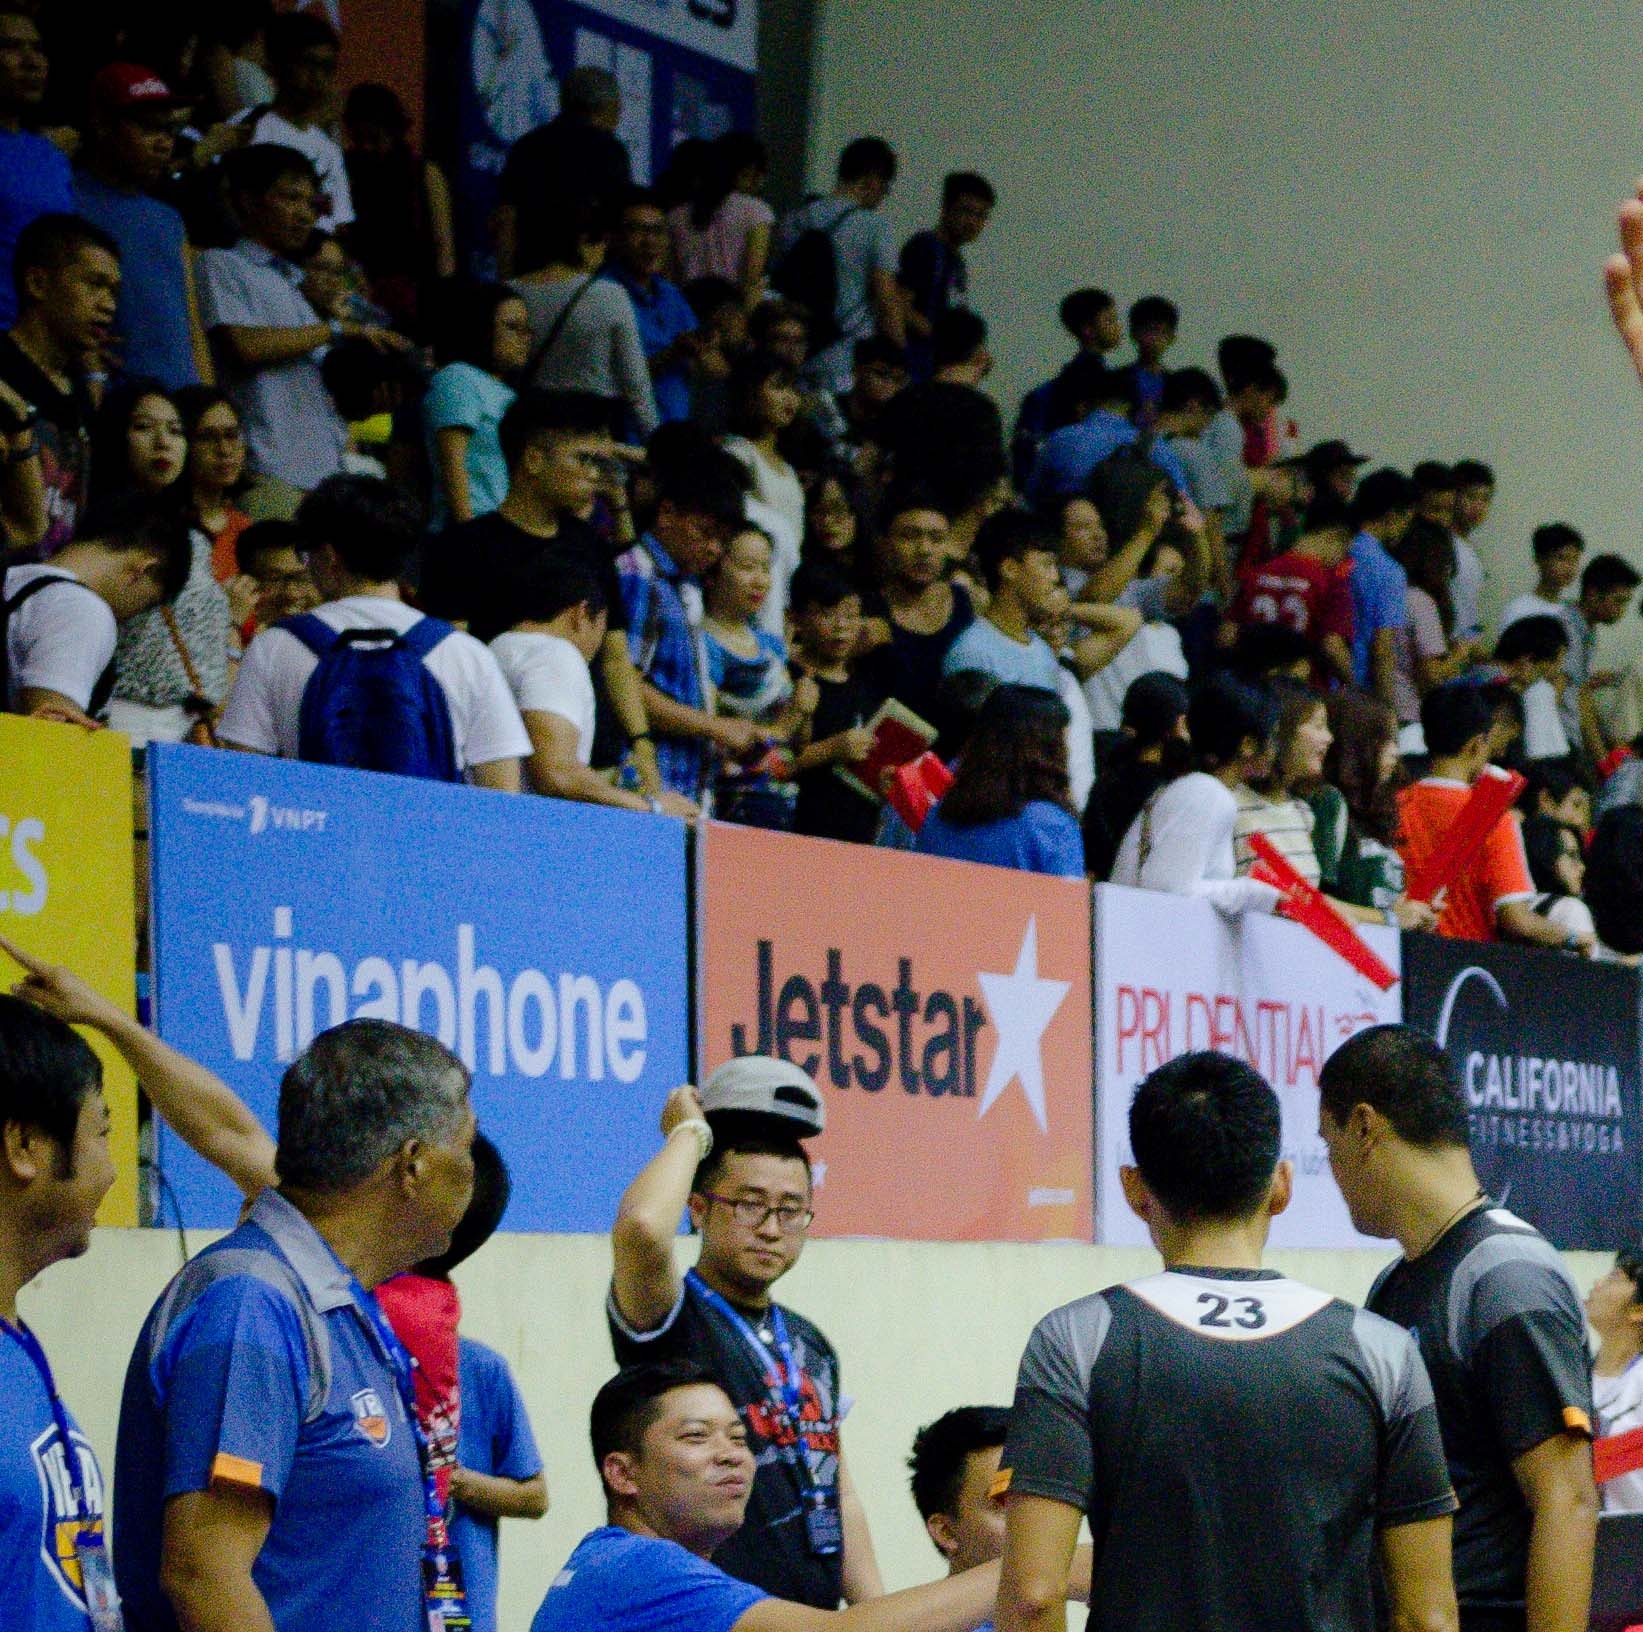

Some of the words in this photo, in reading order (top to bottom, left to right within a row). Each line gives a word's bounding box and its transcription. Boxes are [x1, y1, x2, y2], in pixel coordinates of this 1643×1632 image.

[731, 939, 987, 1099] Jetstar
[1465, 1050, 1624, 1119] CALIFORNIA
[1196, 1292, 1268, 1330] 23
